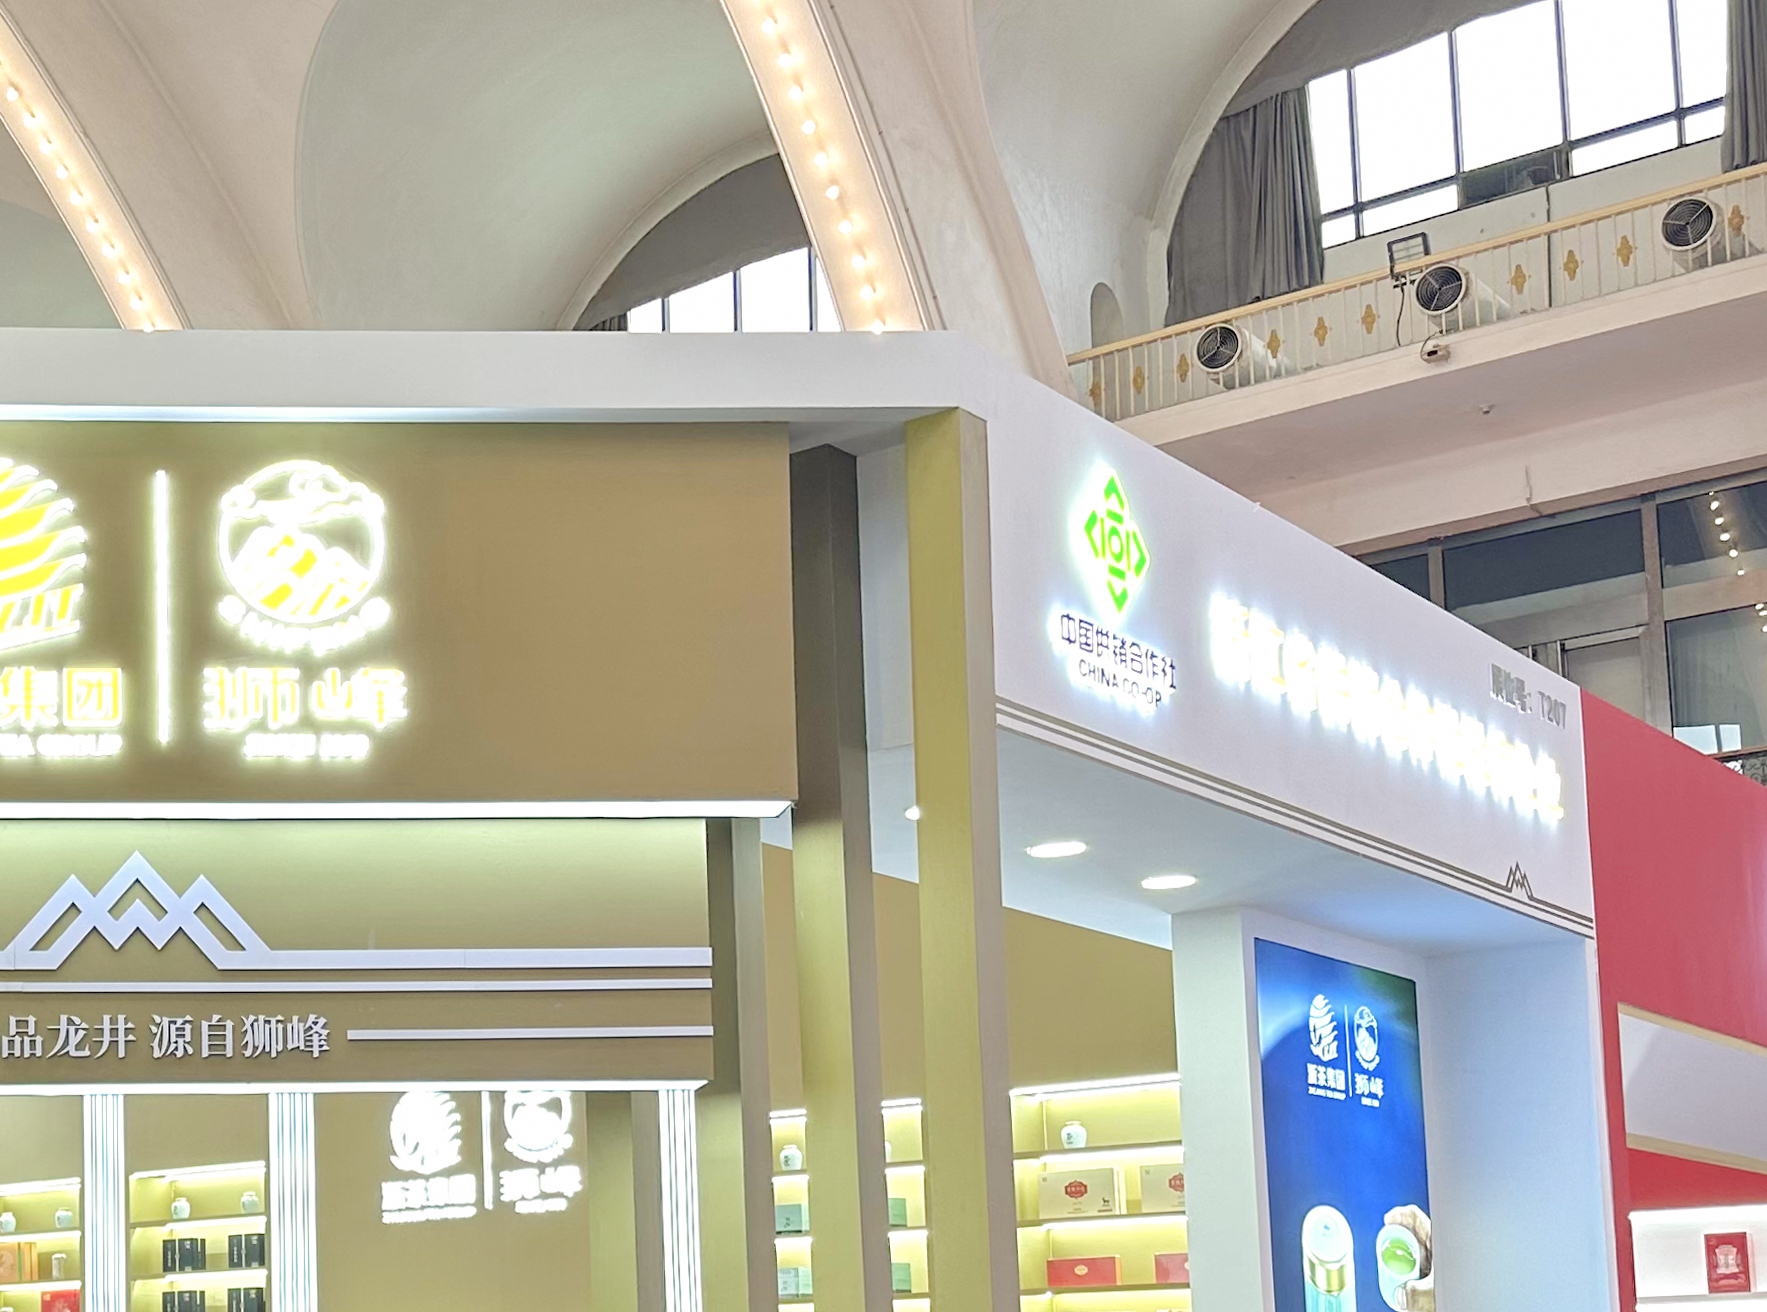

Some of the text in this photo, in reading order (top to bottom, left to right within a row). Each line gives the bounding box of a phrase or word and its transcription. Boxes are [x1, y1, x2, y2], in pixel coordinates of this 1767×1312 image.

[1060, 612, 1177, 691] 中国供销合作社
[1078, 657, 1162, 708] CHINA CO-OP
[1537, 690, 1567, 730] T207
[149, 1013, 331, 1059] 源自狮峰
